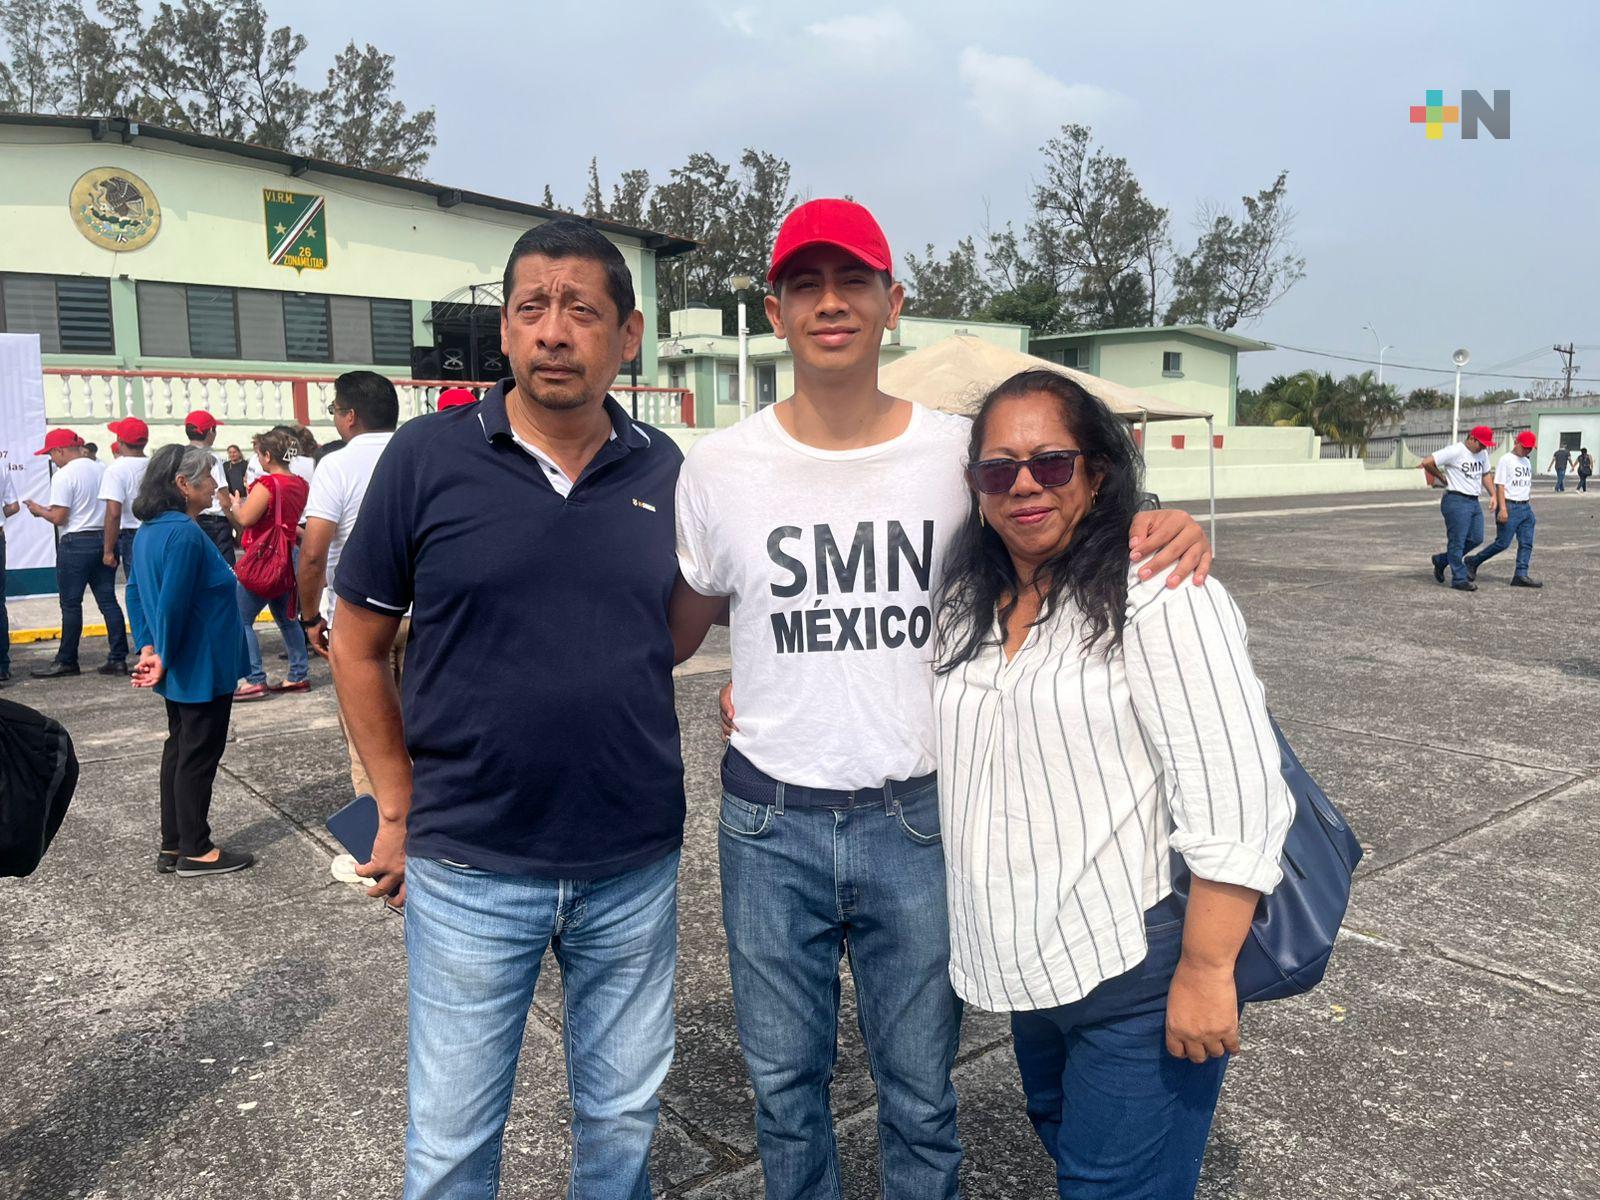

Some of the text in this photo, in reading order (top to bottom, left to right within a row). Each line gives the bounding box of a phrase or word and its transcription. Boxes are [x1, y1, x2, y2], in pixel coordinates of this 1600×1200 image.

[299, 246, 311, 257] 26
[767, 520, 934, 597] SMN
[770, 599, 932, 653] MÉXICO
